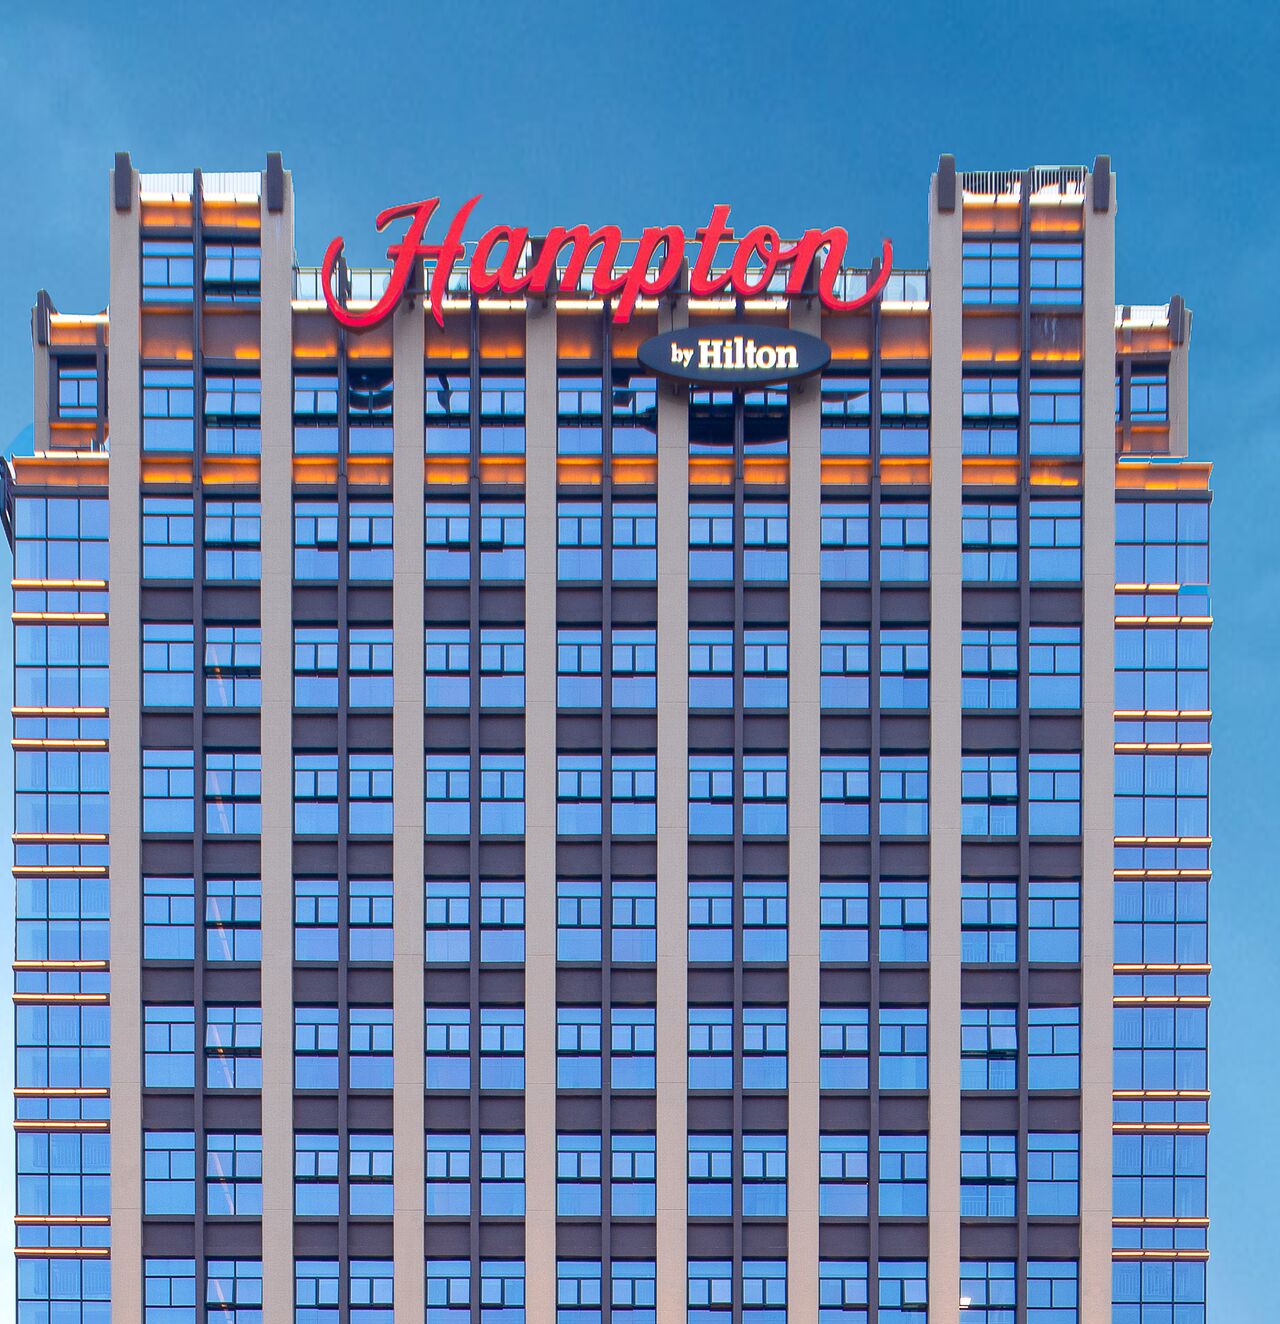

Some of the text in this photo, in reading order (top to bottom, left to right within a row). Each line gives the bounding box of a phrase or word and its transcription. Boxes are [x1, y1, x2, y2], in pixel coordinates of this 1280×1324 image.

[321, 194, 893, 328] Hampton
[671, 336, 799, 369] by Hilton
